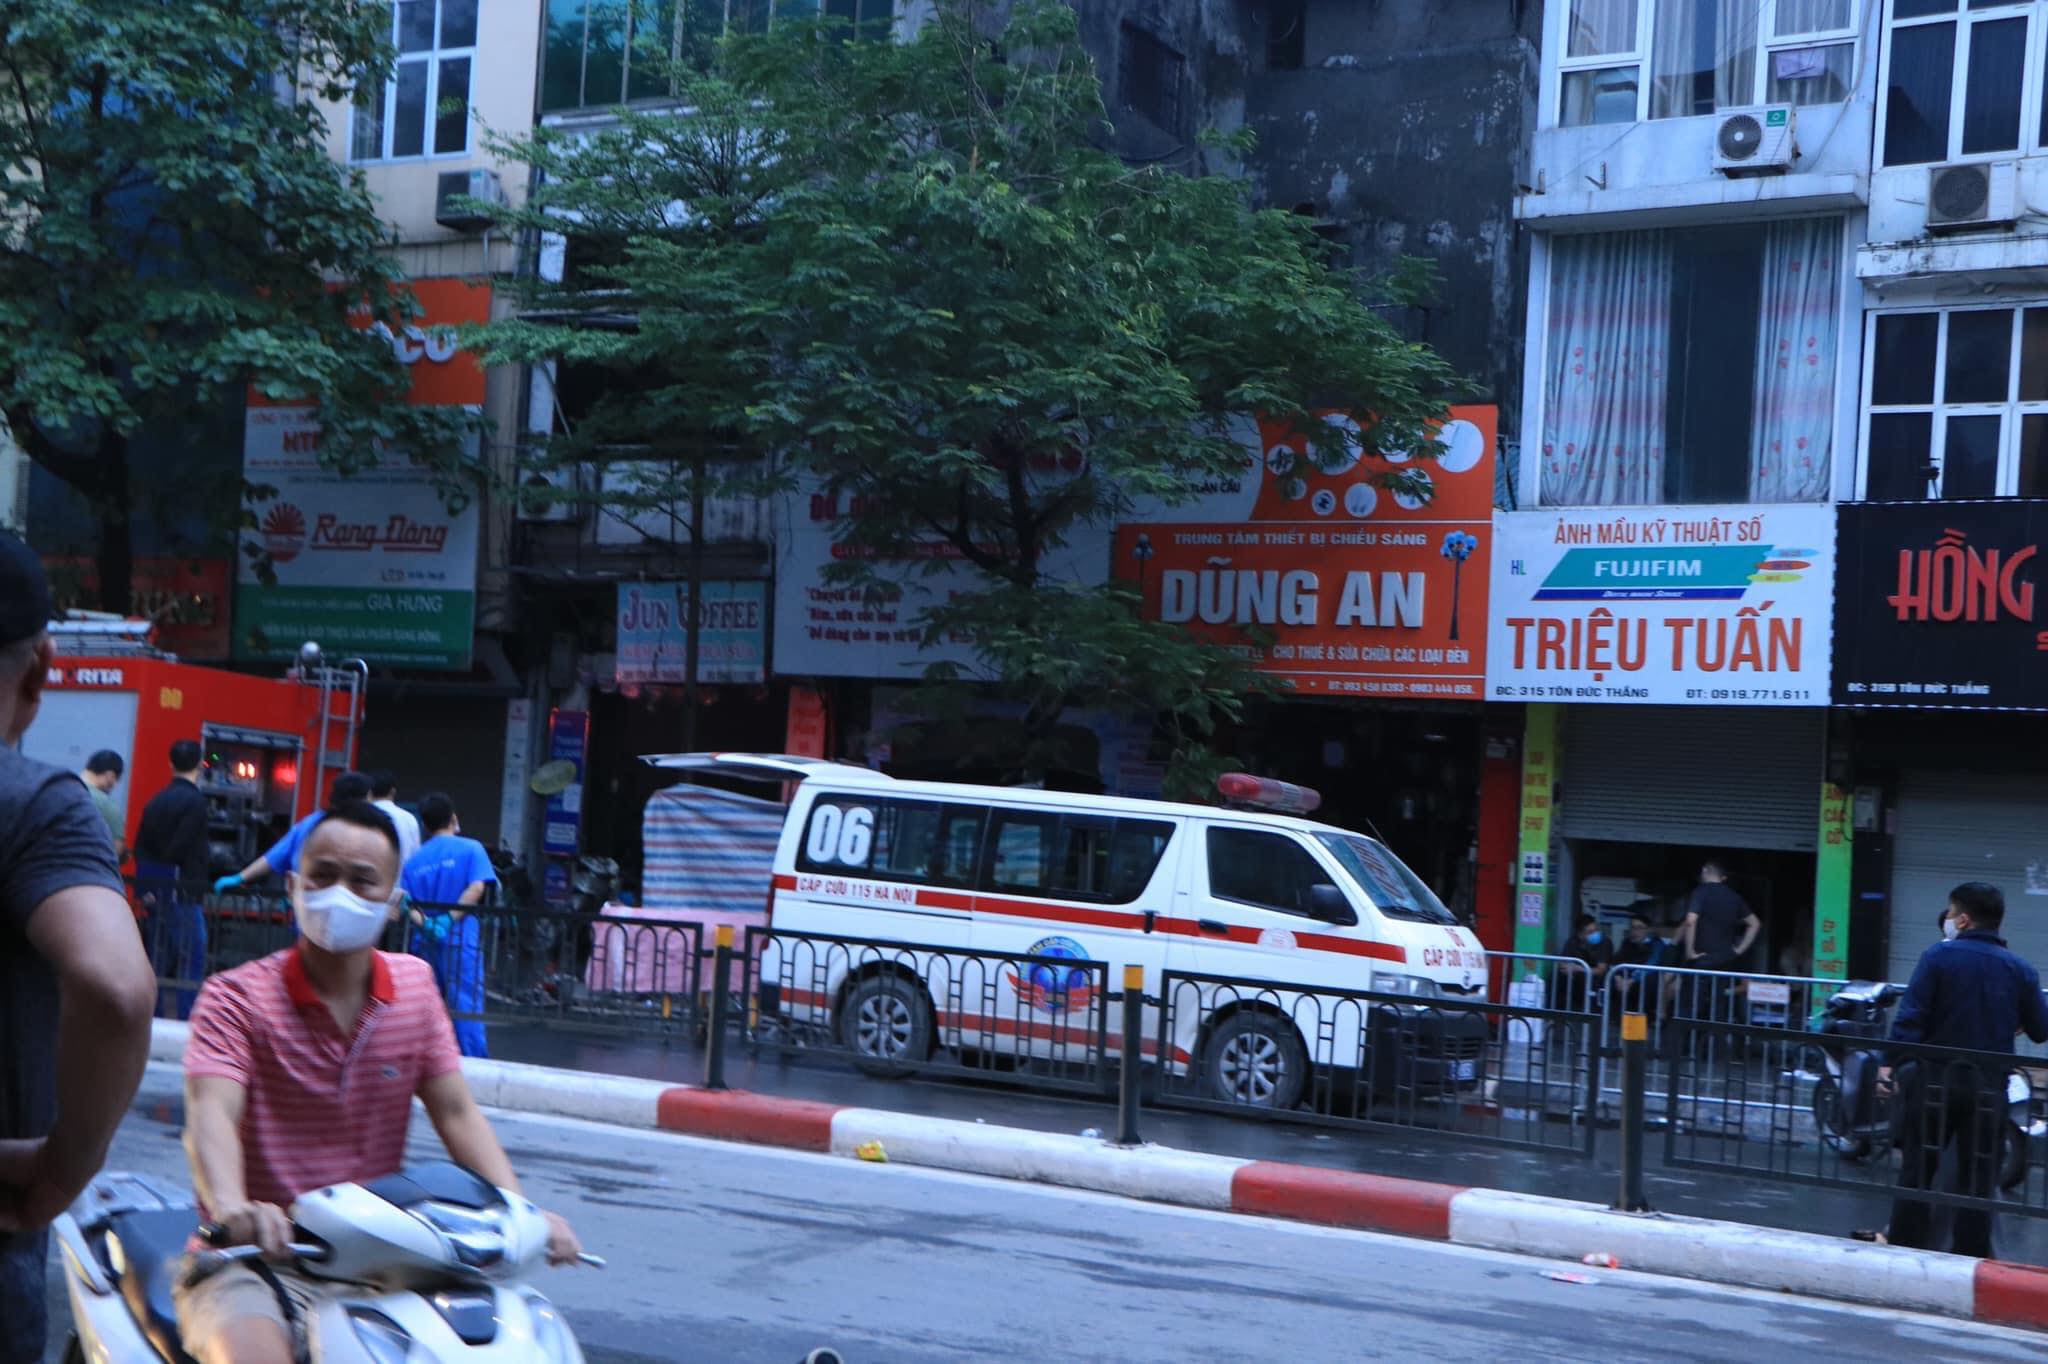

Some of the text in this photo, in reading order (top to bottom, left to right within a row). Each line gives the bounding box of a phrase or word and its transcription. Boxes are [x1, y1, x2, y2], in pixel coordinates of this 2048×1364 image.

[1173, 533, 1222, 544] TRUNG
[1227, 531, 1259, 544] TÂM
[1263, 527, 1305, 544] THIẾT
[1331, 528, 1376, 545] CHIẾU
[1381, 529, 1427, 545] SÁNG
[1555, 517, 1592, 544] ẢNH
[1642, 518, 1667, 543] KỸ
[1672, 517, 1732, 546] THUẬT
[1736, 514, 1765, 542] SỐ
[1511, 560, 1526, 575] HL
[1594, 560, 1702, 577] FUJIFIM
[1888, 528, 2037, 621] HỒNG
[1161, 556, 1425, 628] DŨNG AN
[368, 595, 392, 610] GIA
[623, 589, 670, 630] JUN
[1506, 601, 1802, 681] TRIỆU TUẤN
[1273, 645, 1295, 658] CHO
[1394, 645, 1416, 662] CÁC
[48, 667, 123, 684] MRITA
[1496, 686, 1516, 696] ĐC:
[1520, 686, 1544, 696] 315
[1549, 685, 1572, 696] TÔN
[1576, 686, 1601, 697] ĐỨC
[1711, 689, 1809, 700] 0919.771.611
[807, 804, 874, 866] 06
[852, 884, 871, 898] 115
